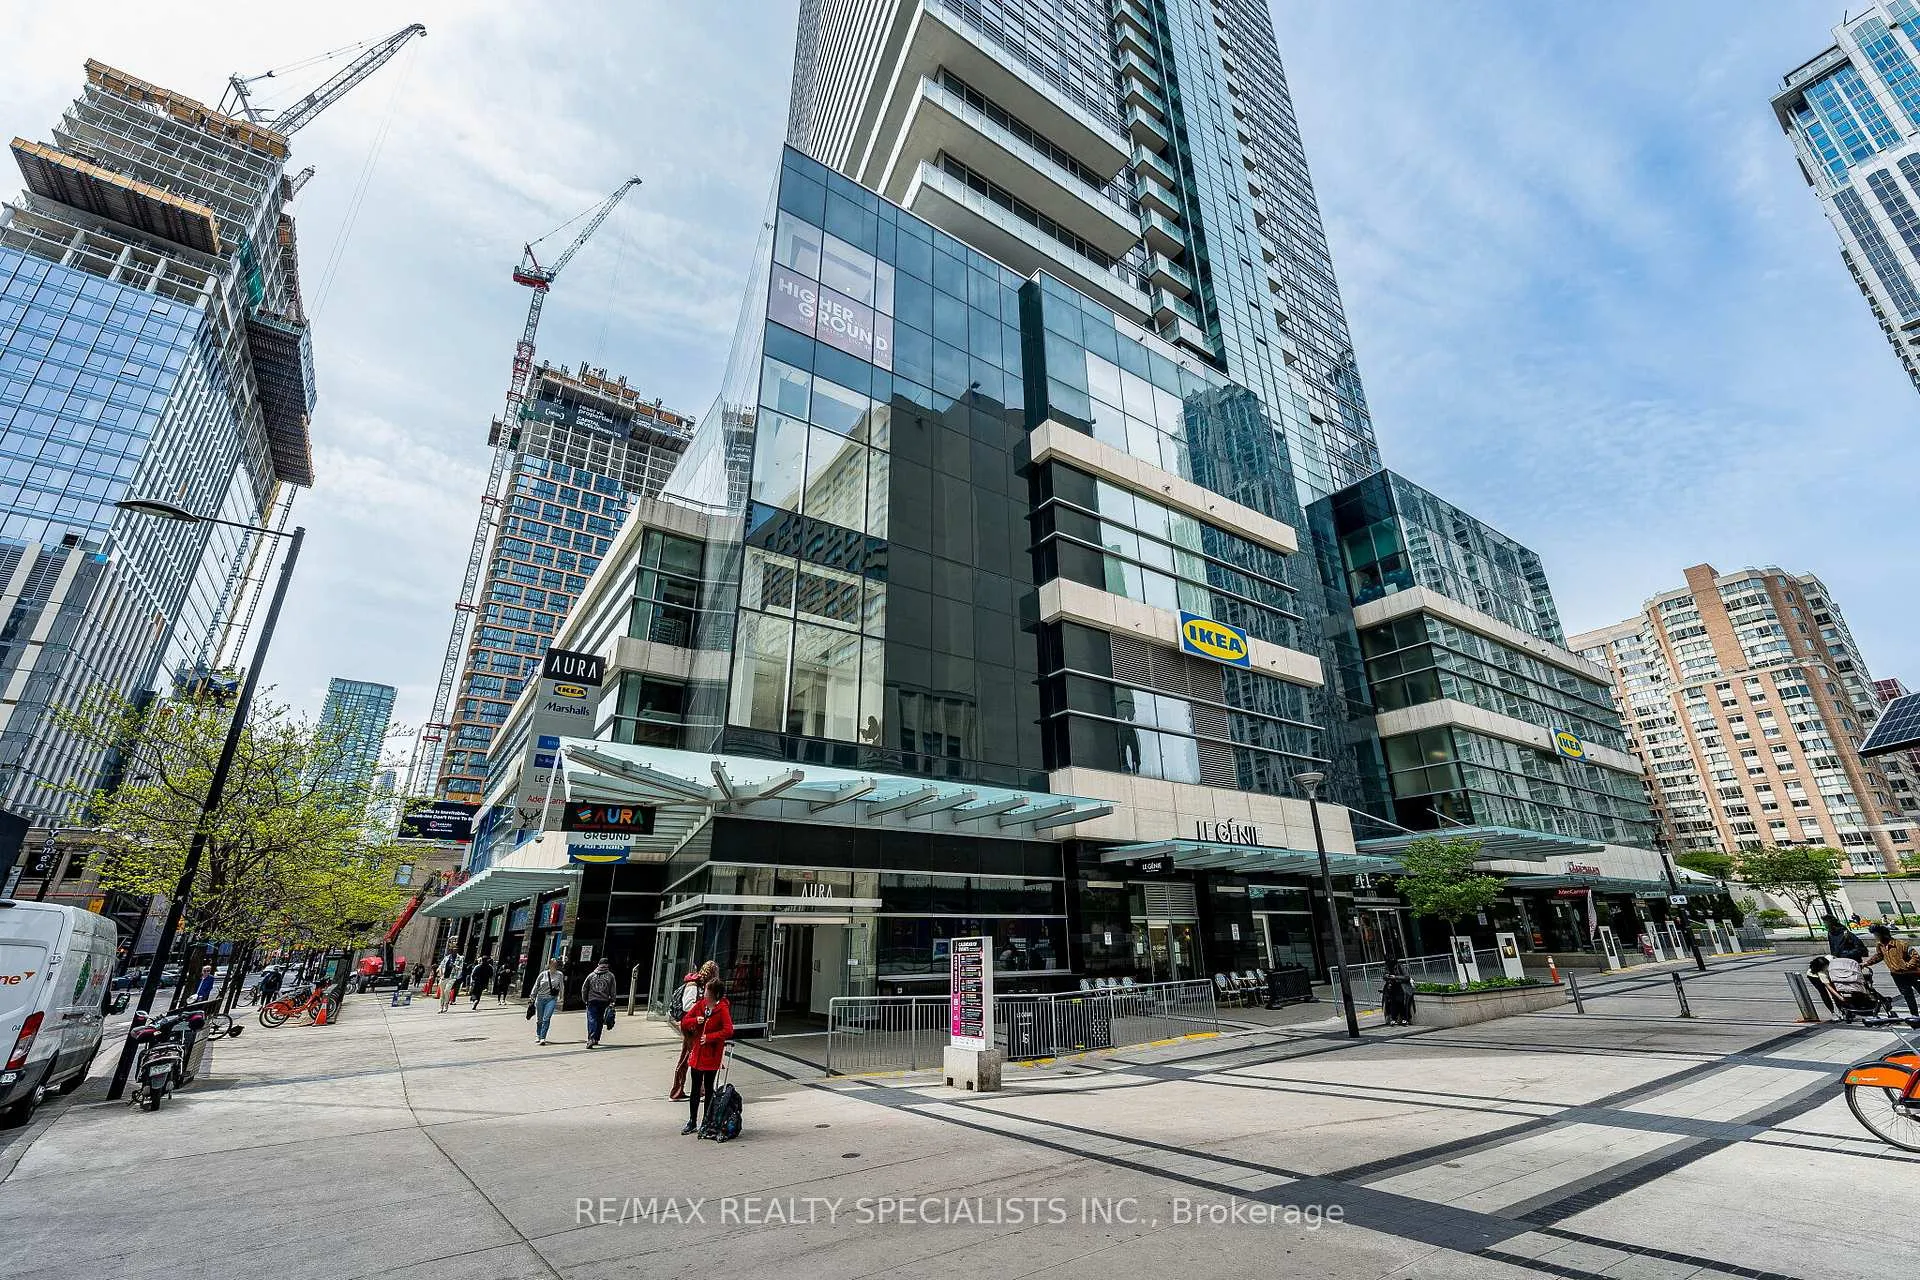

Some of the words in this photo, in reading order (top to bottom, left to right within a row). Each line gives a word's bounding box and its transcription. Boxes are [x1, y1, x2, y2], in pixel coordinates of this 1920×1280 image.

[778, 278, 853, 323] HIGHER
[798, 302, 888, 351] GROUND
[1189, 624, 1243, 654] IKEA
[551, 655, 596, 679] AURA
[557, 686, 585, 696] IKEA
[544, 701, 590, 716] Marshalls
[1558, 736, 1582, 752] IKEA
[534, 774, 544, 783] LE
[594, 806, 644, 825] AURA
[583, 832, 631, 841] GROUND
[1195, 820, 1214, 842] LE
[1214, 817, 1264, 847] GÉNIE
[801, 883, 833, 898] AURA
